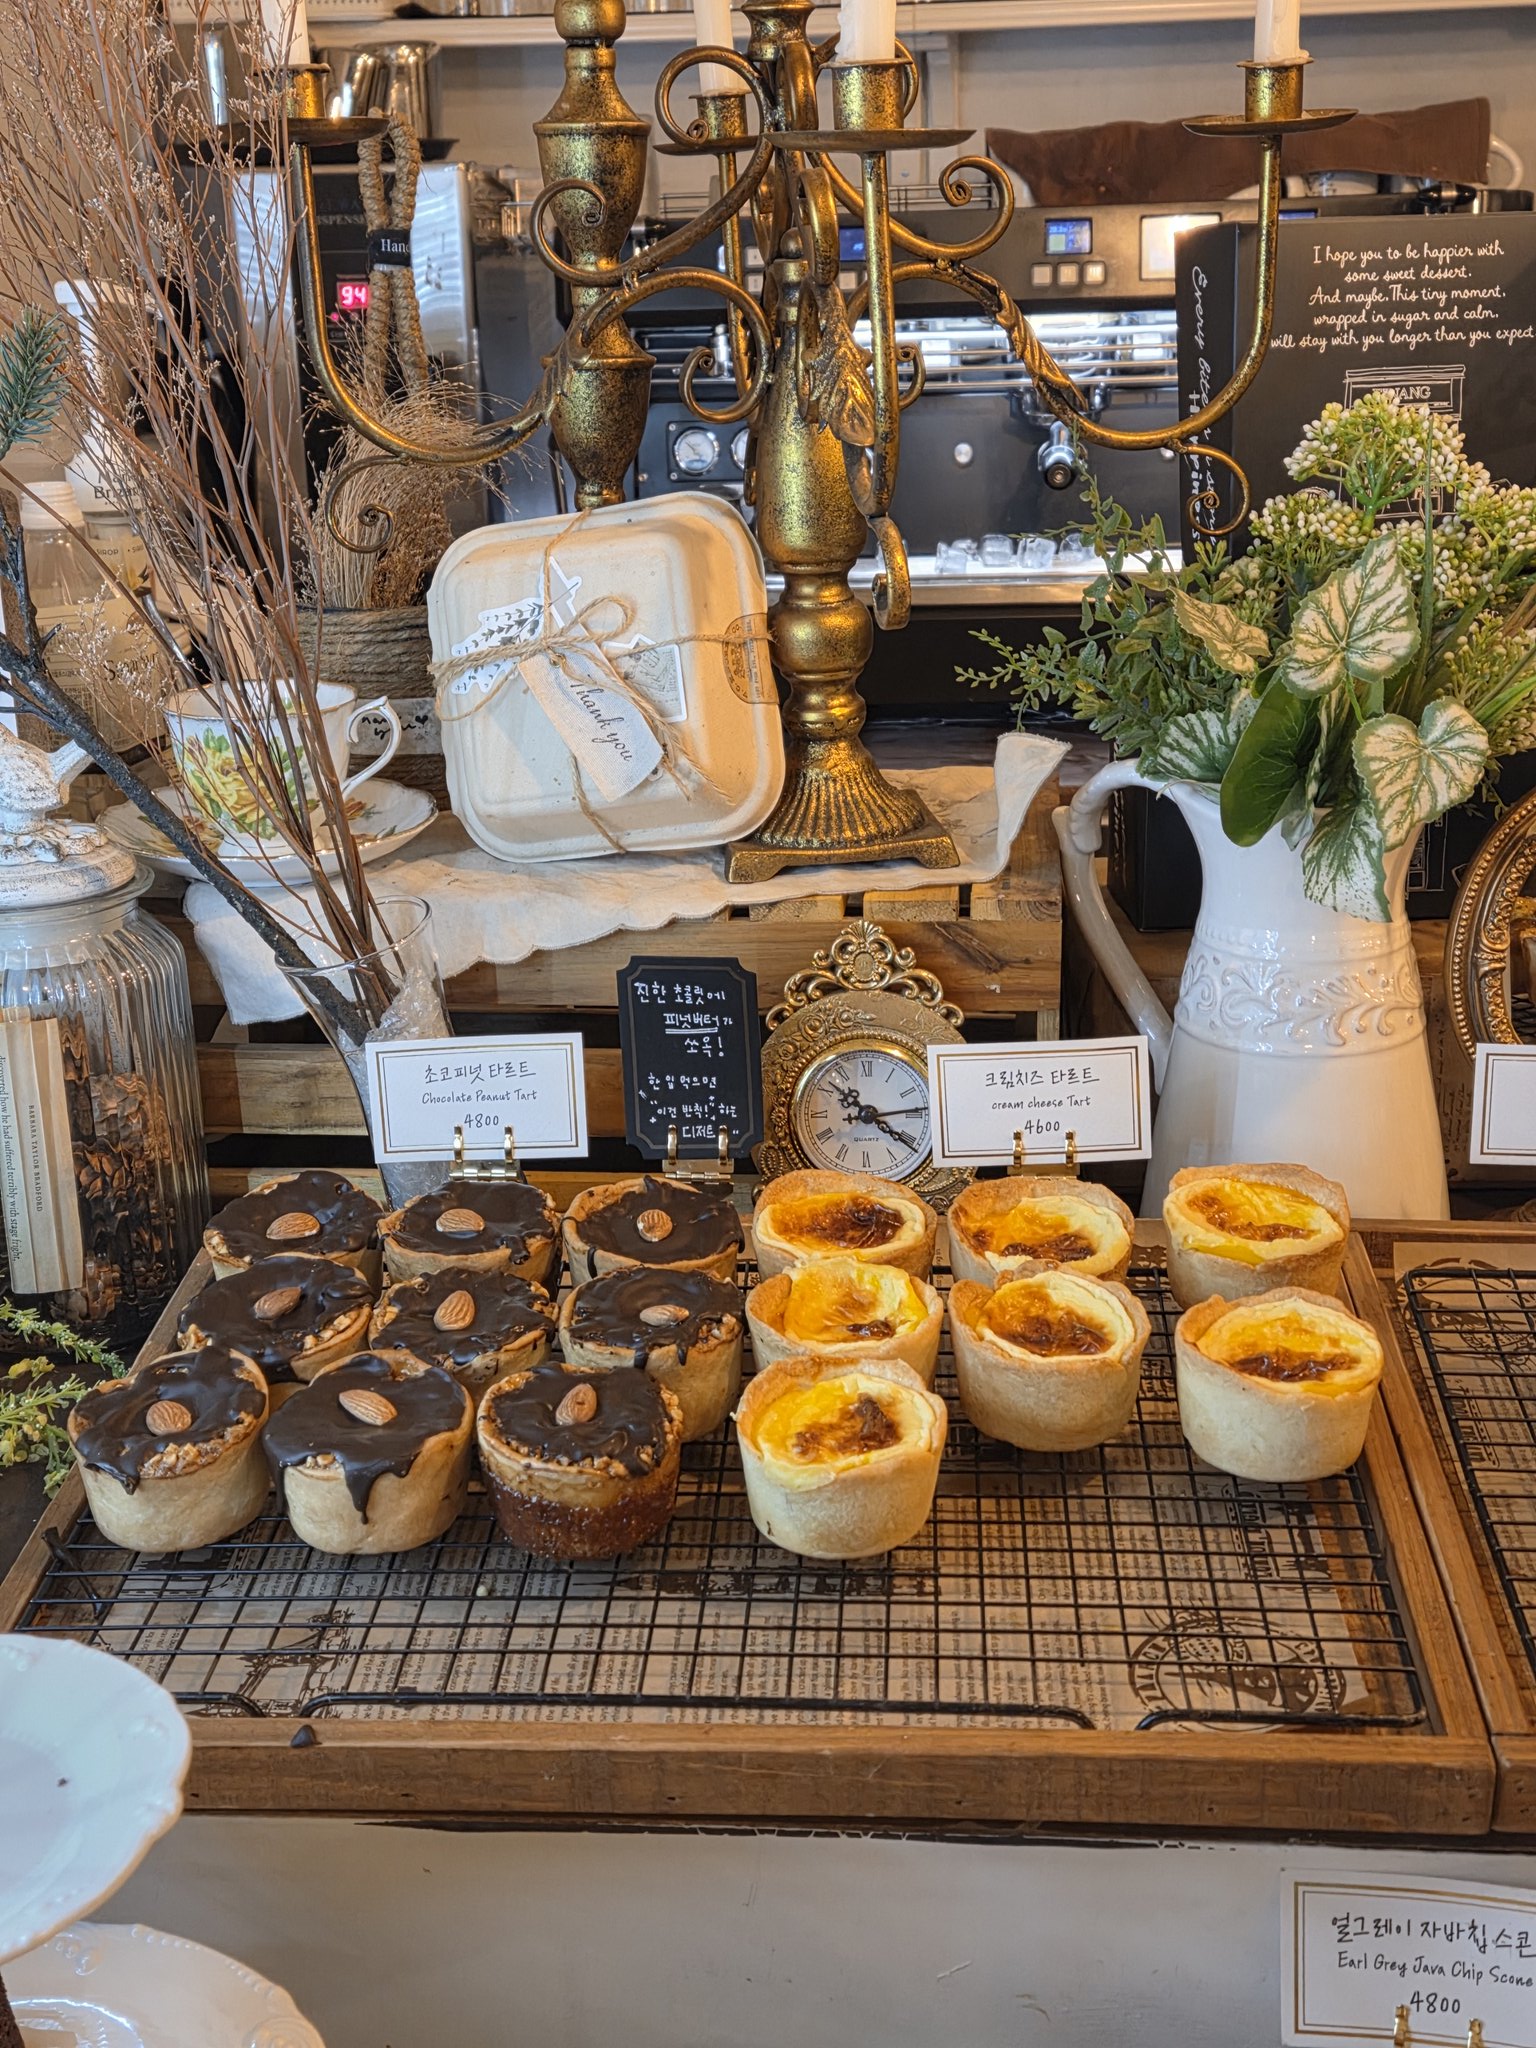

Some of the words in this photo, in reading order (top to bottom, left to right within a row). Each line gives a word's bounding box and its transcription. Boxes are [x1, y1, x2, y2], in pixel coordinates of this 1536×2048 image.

[1313, 245, 1321, 264] I
[1326, 246, 1357, 268] hope
[1360, 249, 1383, 268] you
[1387, 249, 1402, 261] to
[1406, 243, 1420, 260] be
[1423, 242, 1474, 265] happier
[1477, 239, 1505, 256] with
[1344, 269, 1379, 283] some
[1383, 267, 1416, 281] sweet
[1420, 264, 1472, 279] dessert.
[342, 286, 366, 304] 94
[1309, 286, 1341, 305] And
[1389, 283, 1419, 302] This
[1421, 287, 1447, 307] tiny
[1192, 265, 1208, 351] Every
[1313, 308, 1367, 331] wrapped
[1371, 310, 1386, 323] in
[1390, 311, 1430, 329] sugar
[1434, 305, 1459, 320] and
[1271, 333, 1295, 348] will
[1299, 334, 1328, 353] stay
[1331, 329, 1359, 345] with
[1362, 334, 1384, 352] you
[1389, 328, 1433, 350] longer
[1434, 325, 1466, 342] than
[1469, 330, 1492, 348] you
[1199, 357, 1211, 408] bite
[592, 732, 633, 762] you
[634, 981, 667, 1003] 진한
[673, 983, 726, 1005] 초콜릿에
[424, 1063, 486, 1085] 초코피넛
[488, 1060, 537, 1079] 타르트
[680, 1075, 717, 1090] 먹으면
[985, 1068, 1045, 1090] 크림치즈
[1050, 1066, 1101, 1085] 타르트
[1, 1097, 9, 1114] how
[421, 1091, 473, 1105] Chocolate
[475, 1089, 511, 1103] Peanut
[513, 1088, 538, 1101] Tart
[991, 1100, 1025, 1111] cream
[1027, 1096, 1065, 1109] cheese
[1066, 1094, 1092, 1108] Tart
[2, 1114, 11, 1125] he
[463, 1113, 500, 1129] 4800
[718, 1102, 738, 1118] 하는
[3, 1125, 13, 1140] had
[682, 1124, 716, 1139] 디저트
[1024, 1118, 1062, 1136] 4600
[4, 1141, 16, 1170] suffered
[32, 1140, 40, 1170] TAYLOR
[7, 1172, 18, 1199] terribly
[34, 1172, 43, 1212] BRADFORD
[9, 1200, 19, 1218] with
[10, 1218, 20, 1238] stage
[1331, 1912, 1411, 1944] 얼그레이
[1420, 1918, 1489, 1954] 자바칩
[1494, 1928, 1536, 1959] 스콘
[1337, 1951, 1368, 1970] Earl
[1373, 1953, 1408, 1978] Grey
[1412, 1955, 1447, 1978] Java
[1450, 1960, 1485, 1986] Chip
[1488, 1965, 1535, 1988] Scone
[1409, 1990, 1462, 2014] 4800
